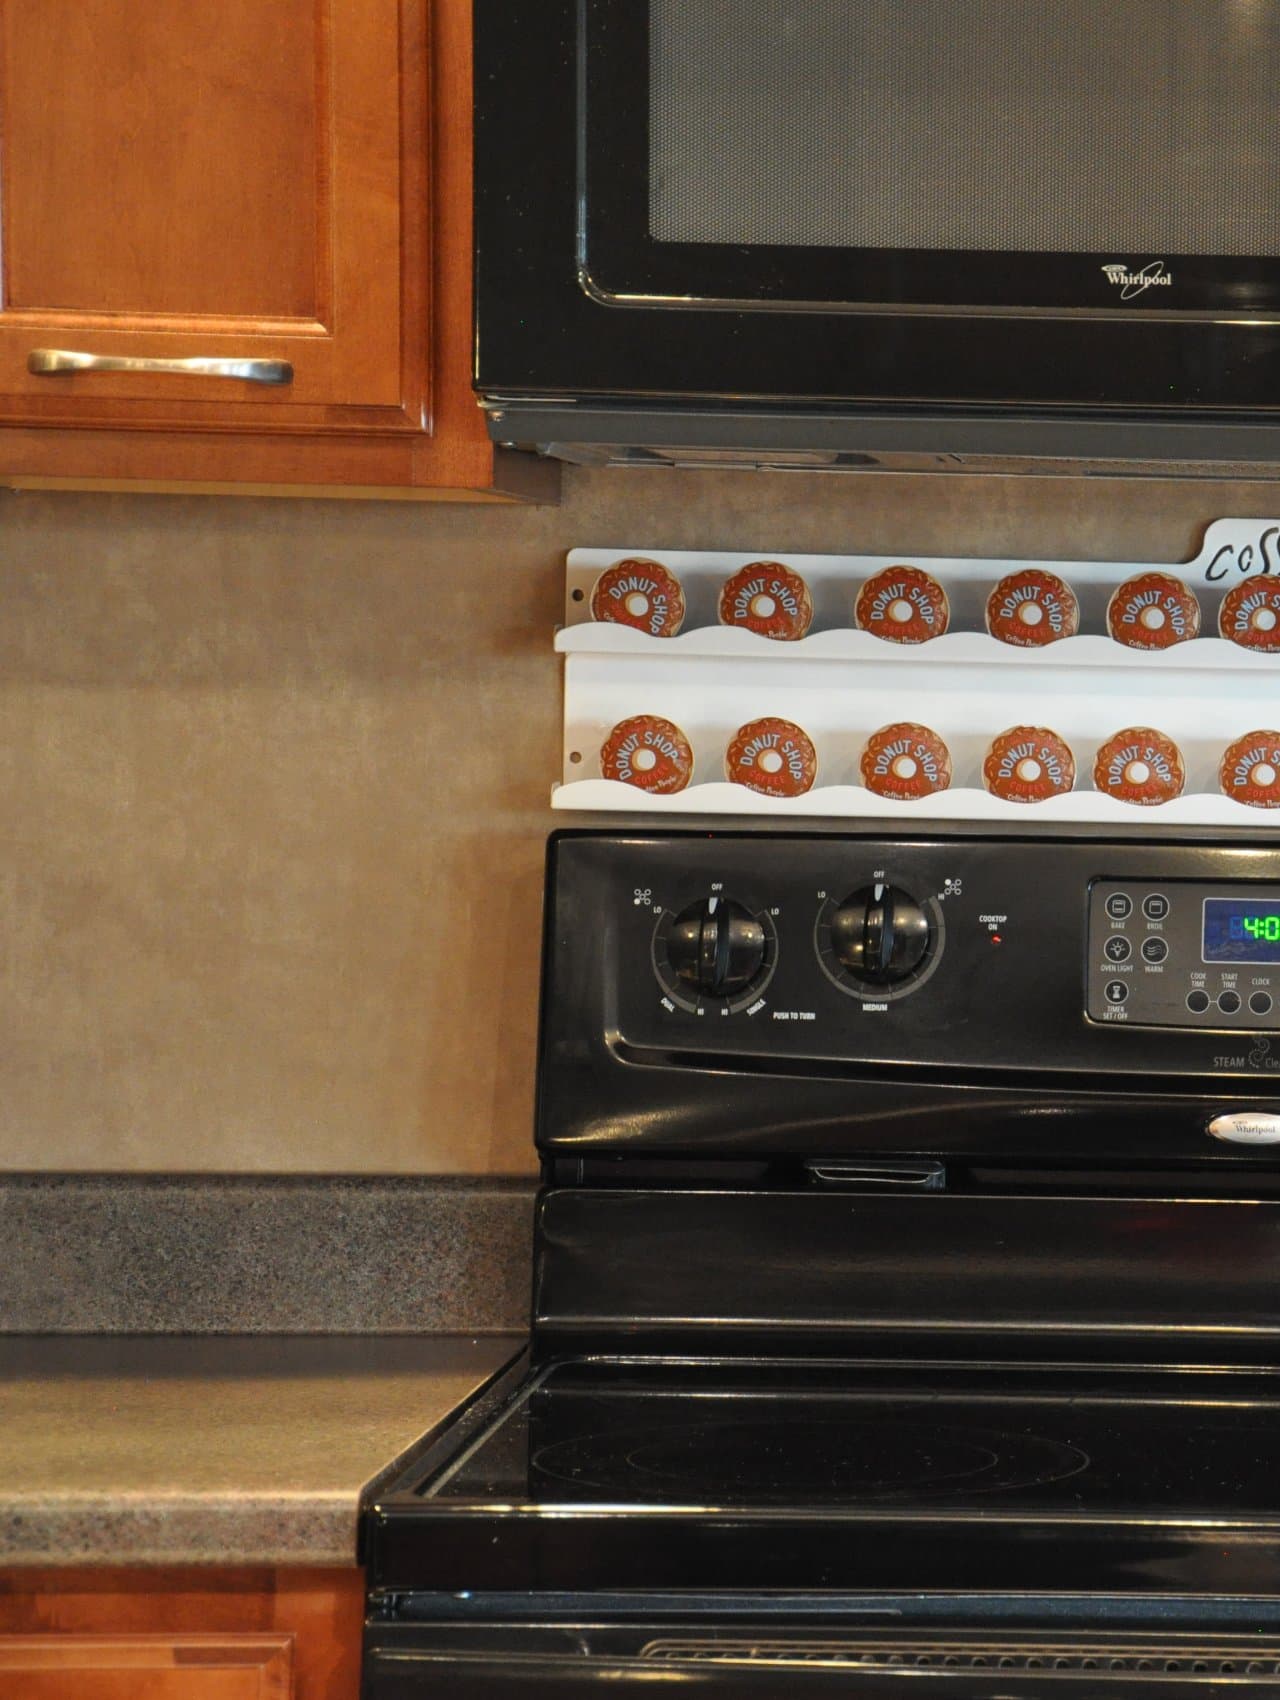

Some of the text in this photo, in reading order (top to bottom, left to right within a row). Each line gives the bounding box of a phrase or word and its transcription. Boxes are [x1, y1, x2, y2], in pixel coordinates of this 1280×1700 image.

[1105, 271, 1172, 289] Whirlpool
[609, 576, 658, 600] DONUT
[648, 594, 668, 634] SHOP
[734, 579, 798, 618] DONUT SHOP
[870, 583, 934, 624] DONUT SHOP
[999, 586, 1062, 633] DONUT SHOP
[1122, 591, 1185, 635] DONUT SHOP
[1234, 592, 1268, 631] DONUT
[616, 731, 679, 780] DONUT SHOP
[740, 733, 803, 780] DONUT SHOP
[873, 740, 938, 782] DONUT SHOP
[998, 743, 1061, 785] DONUT SHOP
[1108, 745, 1171, 785] DONUT SHOP
[1233, 747, 1267, 786] DONUT
[711, 883, 723, 891] OFF
[1251, 978, 1270, 986] CLOCK
[1213, 1056, 1245, 1068] STEAM
